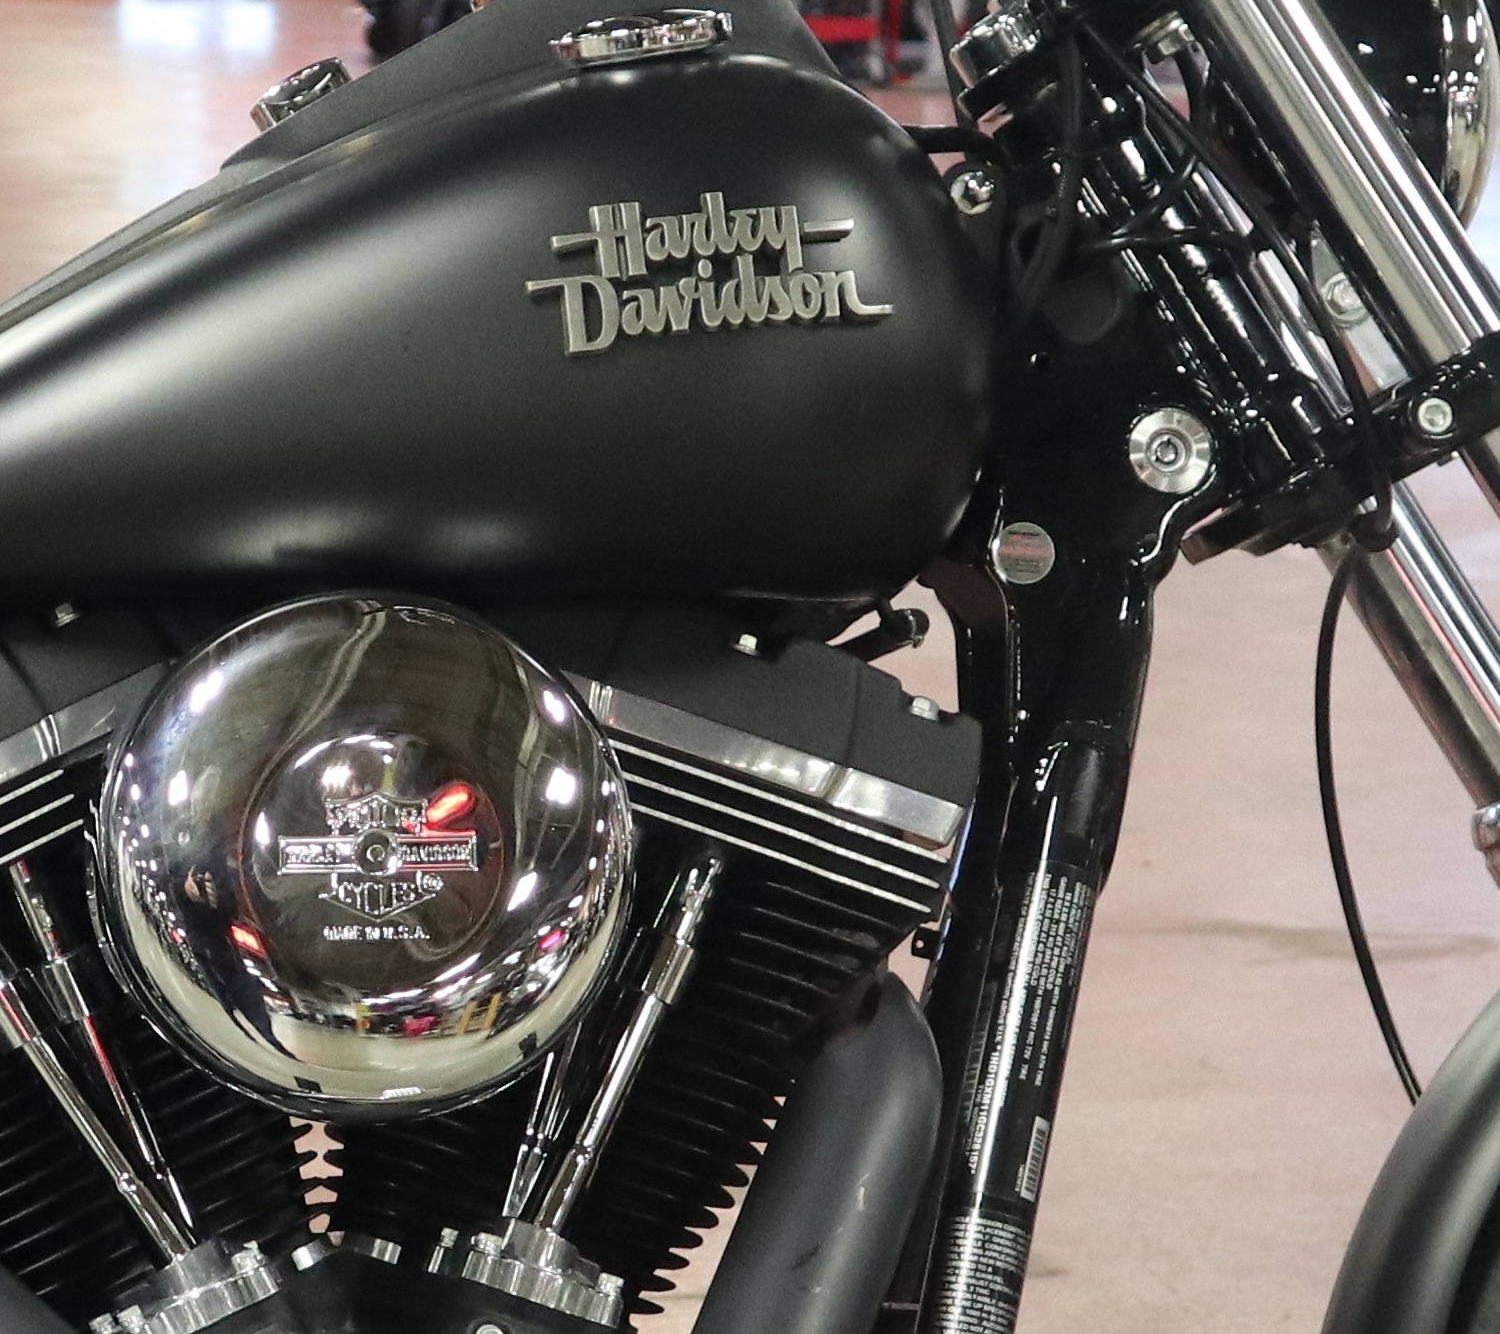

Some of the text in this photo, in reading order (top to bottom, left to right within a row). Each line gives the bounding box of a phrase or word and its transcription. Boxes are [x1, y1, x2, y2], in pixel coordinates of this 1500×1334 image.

[545, 254, 894, 355] Davidson
[338, 881, 416, 915] CYCLES
[1029, 964, 1040, 986] COLD
